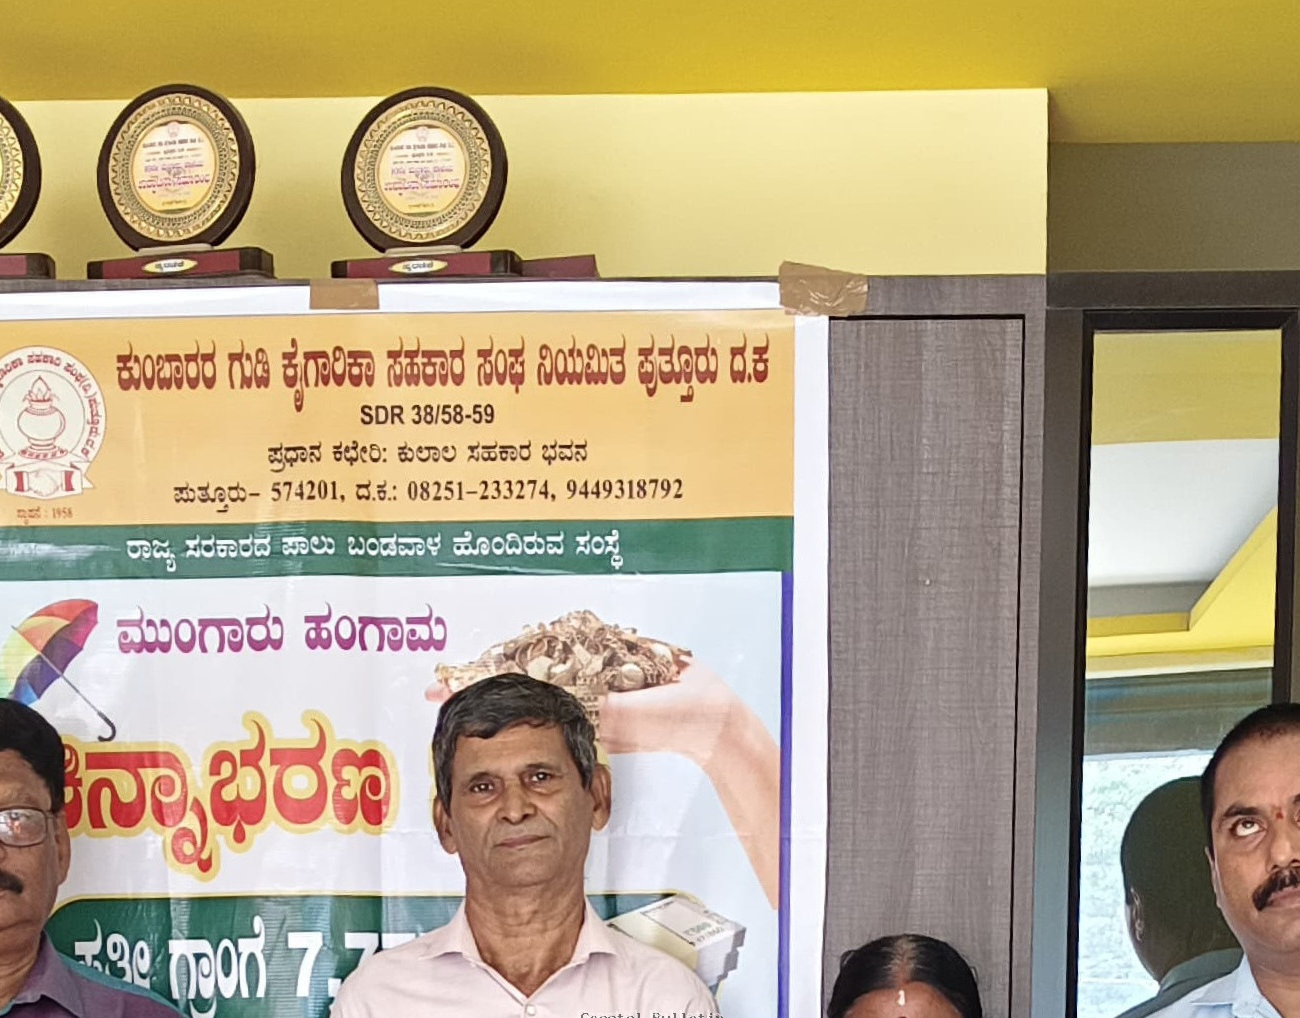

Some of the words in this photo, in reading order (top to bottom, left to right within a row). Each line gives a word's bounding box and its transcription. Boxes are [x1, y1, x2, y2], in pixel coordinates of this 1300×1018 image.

[117, 340, 216, 390] ಕುಂಬಾರರ
[228, 339, 270, 389] ಗುಡಿ
[282, 338, 375, 412] ಕೈಗಾರಿಕಾ
[387, 336, 465, 387] ಸಹಕಾರ
[477, 335, 525, 394] ಸಂಘ
[537, 333, 626, 386] ನಿಯಮಿತ
[637, 333, 719, 402] ಪುತ್ತೂರು
[729, 332, 769, 385] ದ.ಕ
[360, 404, 405, 425] SDR
[411, 403, 495, 425] 38/58-59
[267, 441, 322, 473] ಪ್ರಧಾನ
[332, 440, 388, 467] ಕಛೇರಿ:
[397, 441, 457, 463] ಕುಲಾಲ
[467, 440, 531, 464] ಸಹಕಾರ
[542, 439, 588, 465] ಭವನ
[271, 479, 345, 503] 574201,
[566, 478, 684, 500] 9449318792
[126, 538, 177, 572] ರಾಜ್ಯ
[185, 533, 271, 558] ಸರಕಾರದ
[281, 533, 336, 556] ಪಾಲು
[347, 532, 442, 558] ಬಂಡವಾಳ
[453, 530, 564, 557] ಹೊಂದಿರುವ
[575, 529, 623, 570] ಸಂಸ್ಥೆ
[116, 603, 285, 655] ಮುಂಗಾರು
[304, 602, 448, 652] ಹಂಗಾಮ
